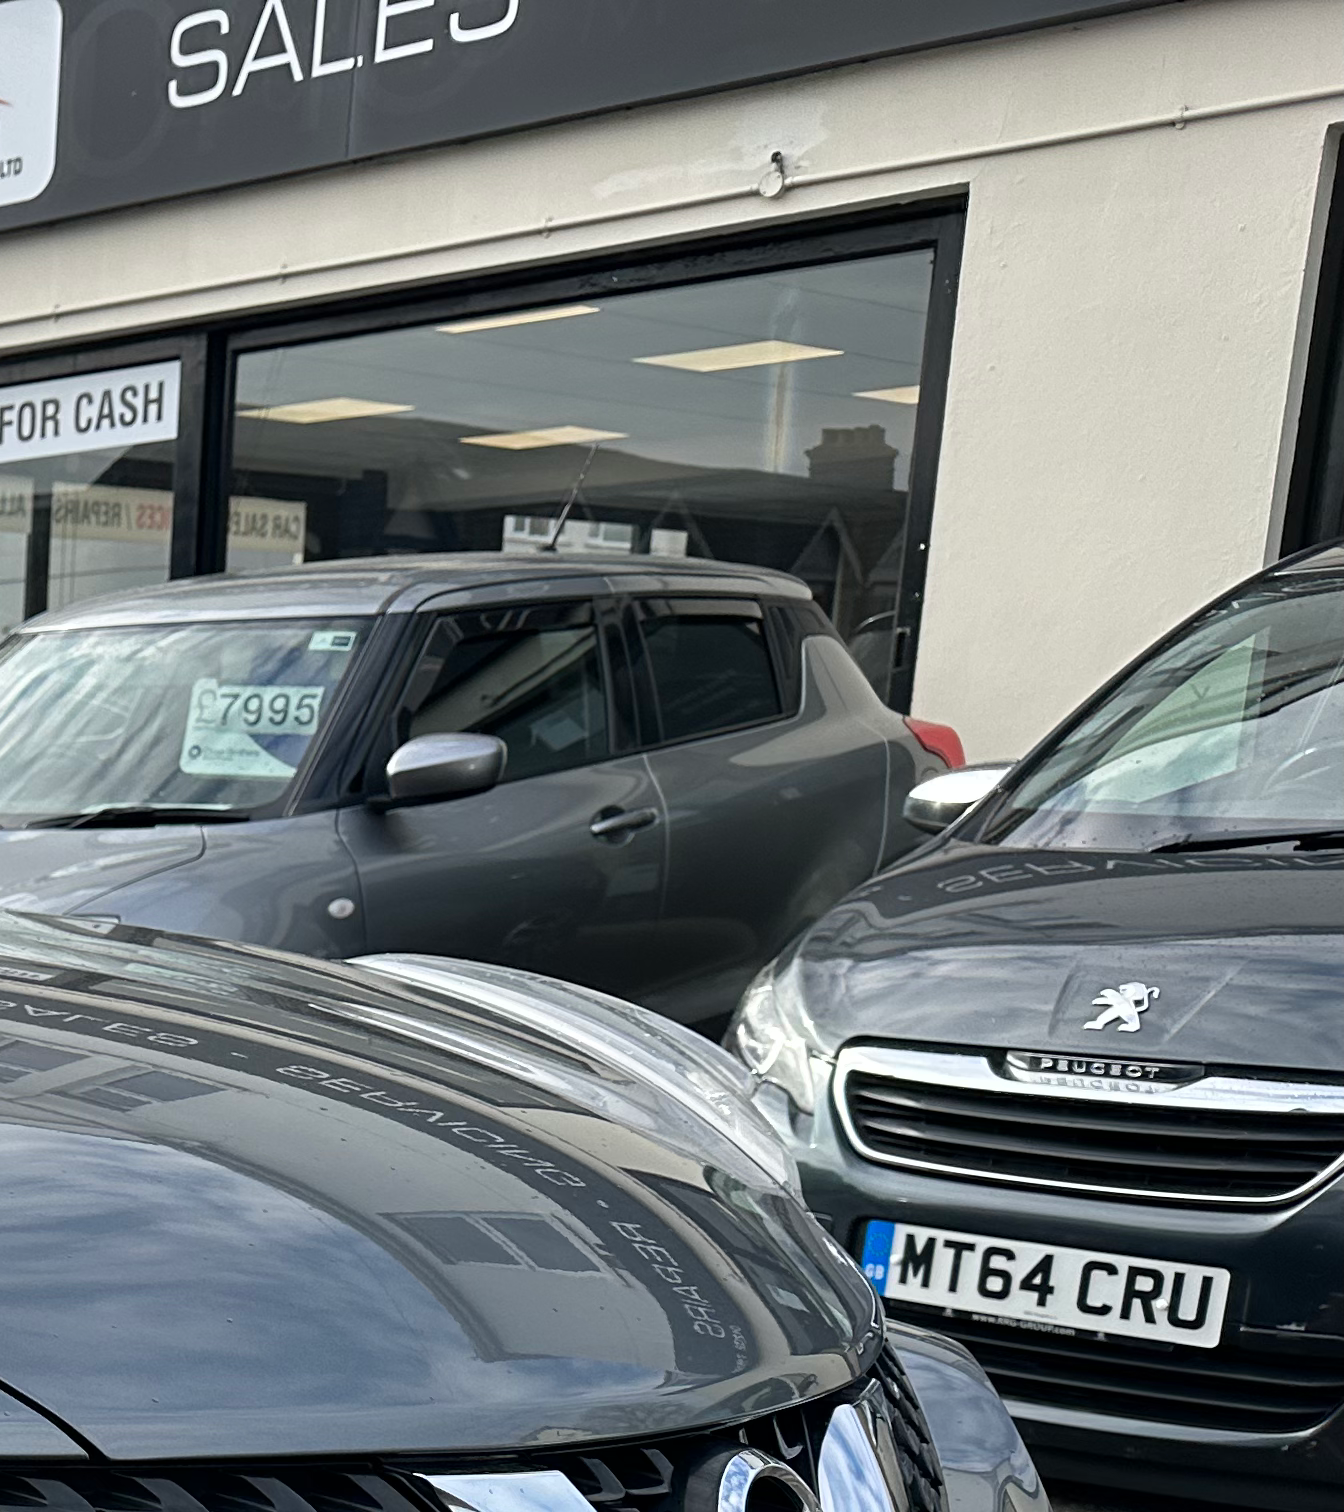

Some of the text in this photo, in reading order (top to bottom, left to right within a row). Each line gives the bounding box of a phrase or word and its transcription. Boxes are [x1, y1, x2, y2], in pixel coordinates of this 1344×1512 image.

[0, 156, 23, 179] LTD
[75, 380, 165, 434] CASH
[195, 688, 319, 727] £7995
[1040, 1057, 1160, 1079] PEUGEOT
[898, 1233, 1214, 1332] MT64 CRU
